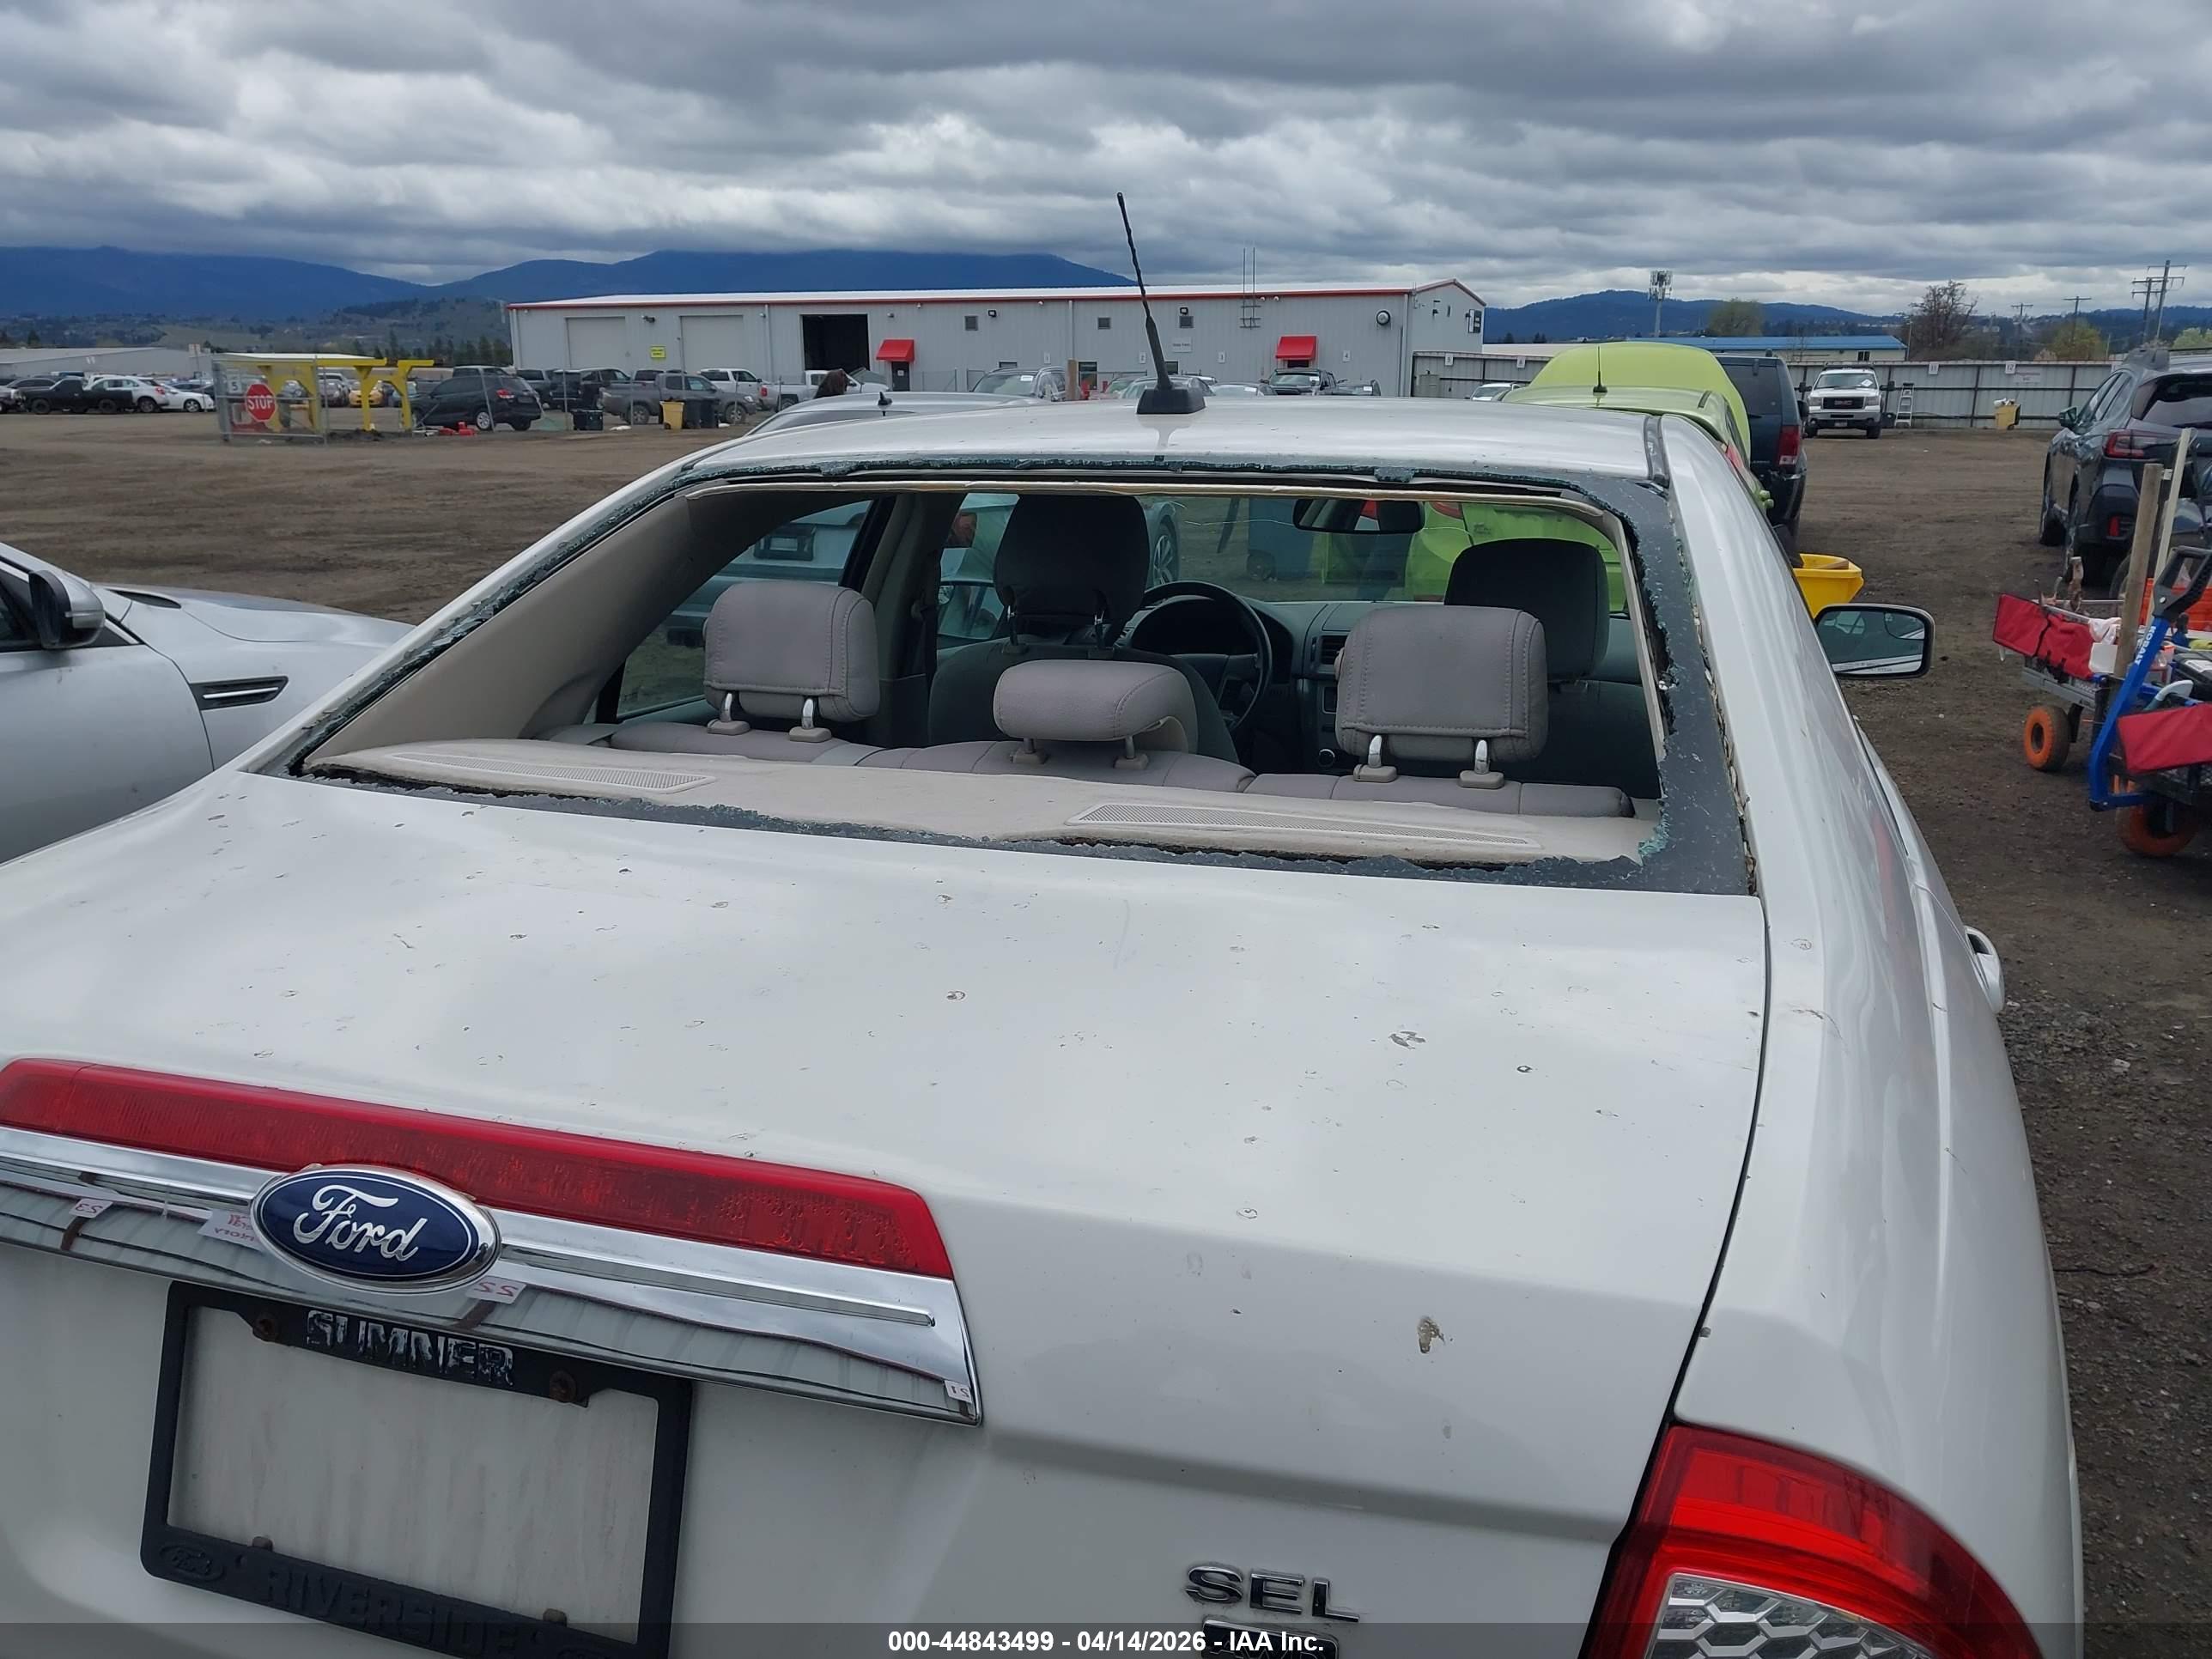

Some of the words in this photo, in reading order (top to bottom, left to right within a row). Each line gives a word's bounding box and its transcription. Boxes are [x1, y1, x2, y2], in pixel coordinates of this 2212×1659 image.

[247, 395, 274, 410] STOP
[2135, 625, 2156, 665] KOBALT
[293, 1184, 428, 1261] Ford
[306, 1310, 514, 1387] SUMNER
[1185, 1565, 1359, 1623] SEL
